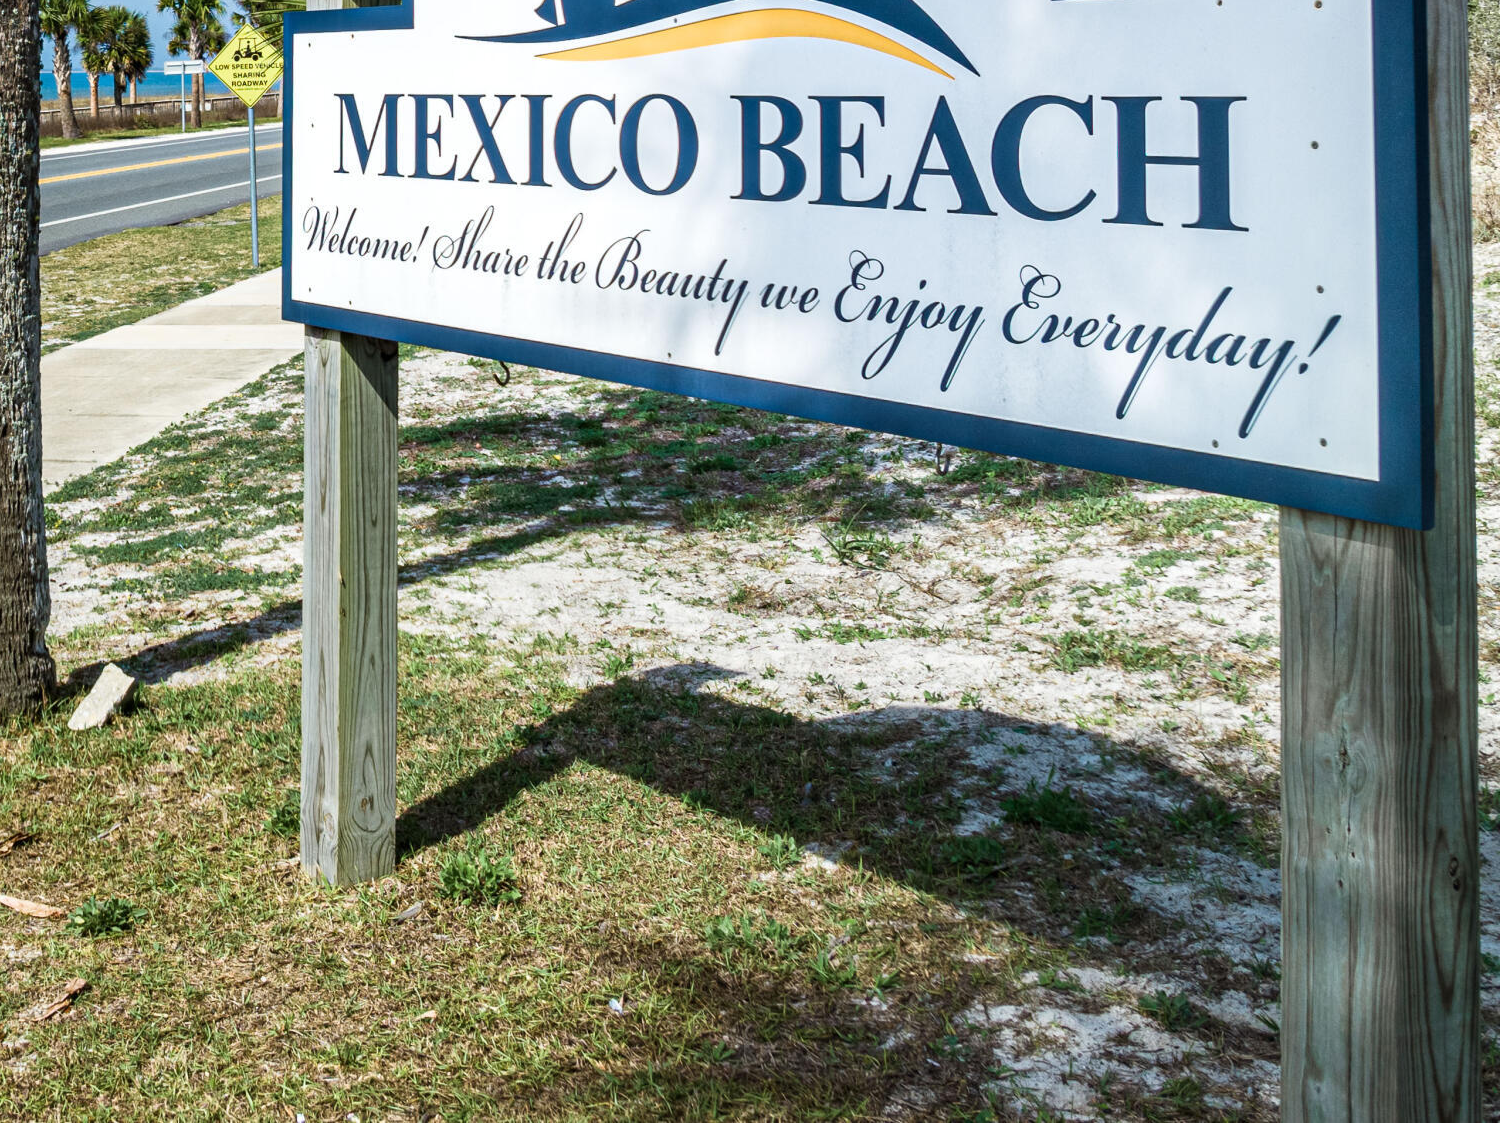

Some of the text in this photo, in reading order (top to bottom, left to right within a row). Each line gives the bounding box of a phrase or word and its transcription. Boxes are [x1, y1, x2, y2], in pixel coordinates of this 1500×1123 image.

[333, 93, 1249, 232] MEXICO BEACH
[302, 205, 1342, 439] Welcome! Share the Beauty we Enjoy Everyday!
